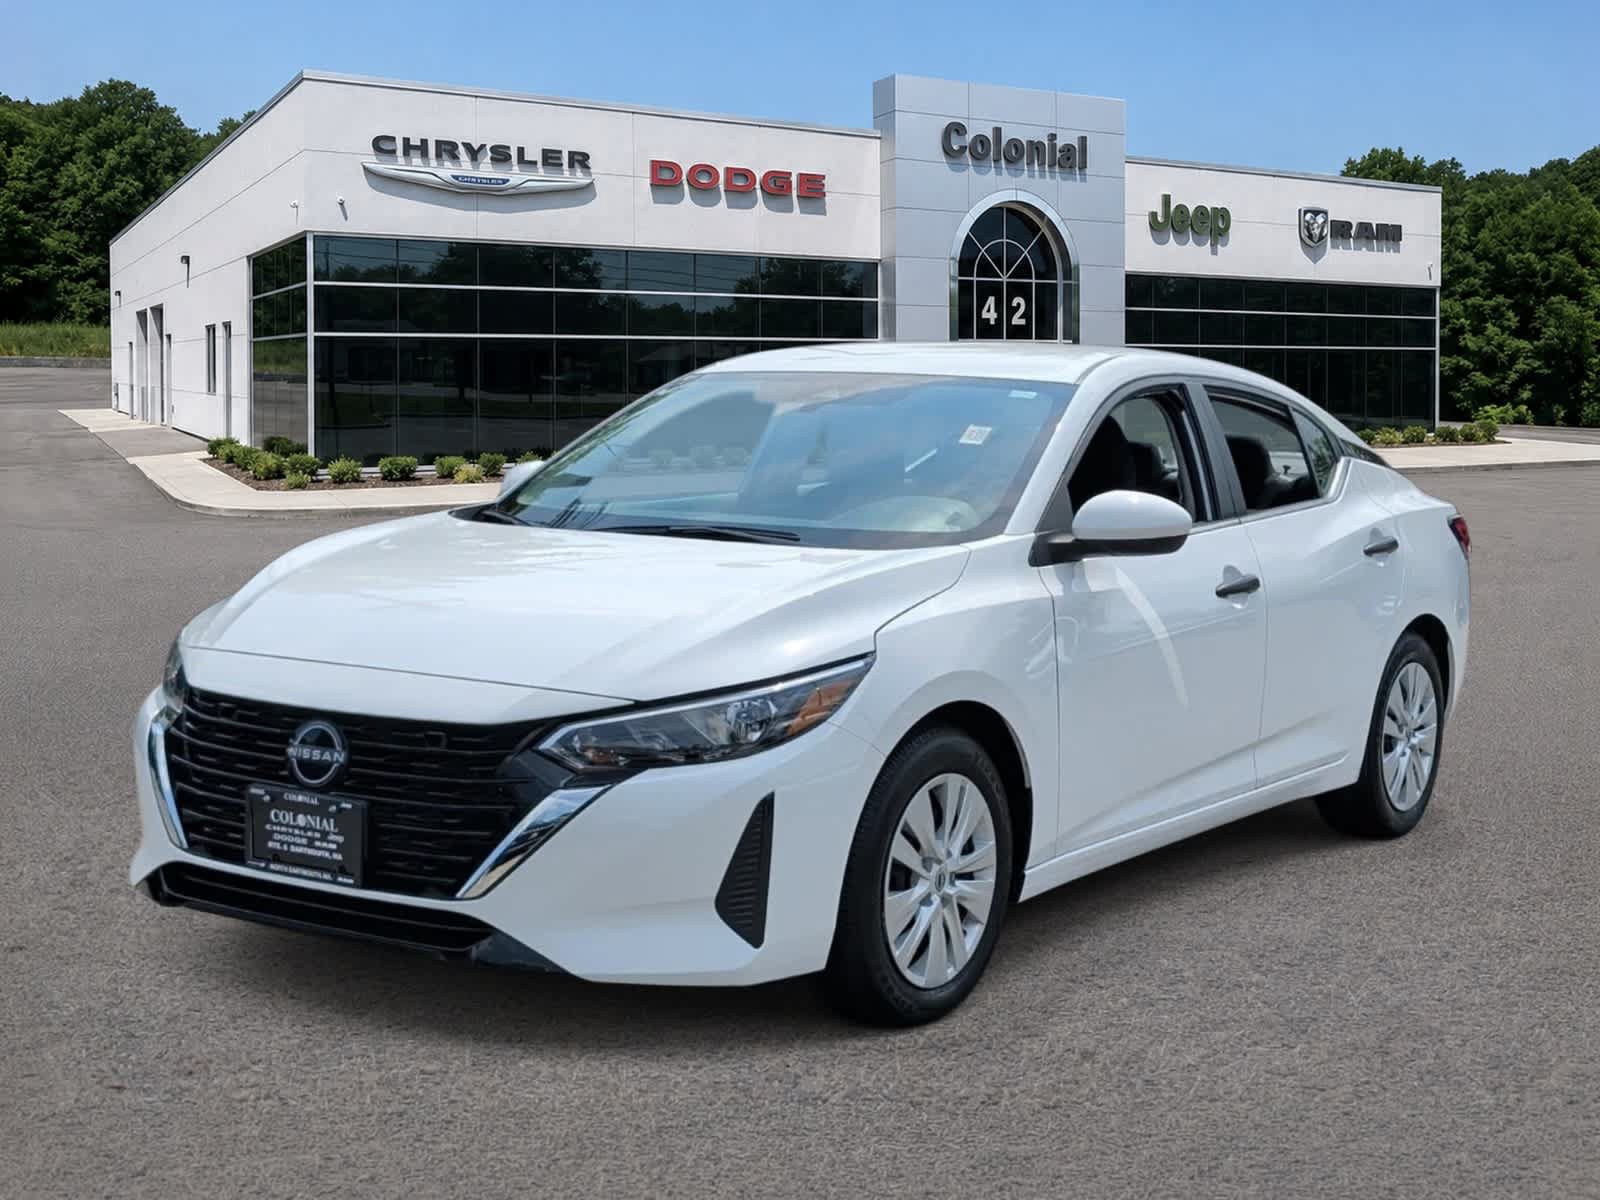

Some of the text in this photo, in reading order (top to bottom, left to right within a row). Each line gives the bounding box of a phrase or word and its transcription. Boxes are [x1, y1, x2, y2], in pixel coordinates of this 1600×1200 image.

[371, 134, 592, 169] CHRYSLER
[941, 121, 1088, 169] Colonial
[649, 159, 827, 199] DODGE
[1147, 193, 1232, 247] Jeep
[1329, 219, 1403, 243] RAM
[287, 746, 346, 763] NISSAN
[269, 808, 339, 833] COLONIAL
[272, 832, 308, 845] DODGE
